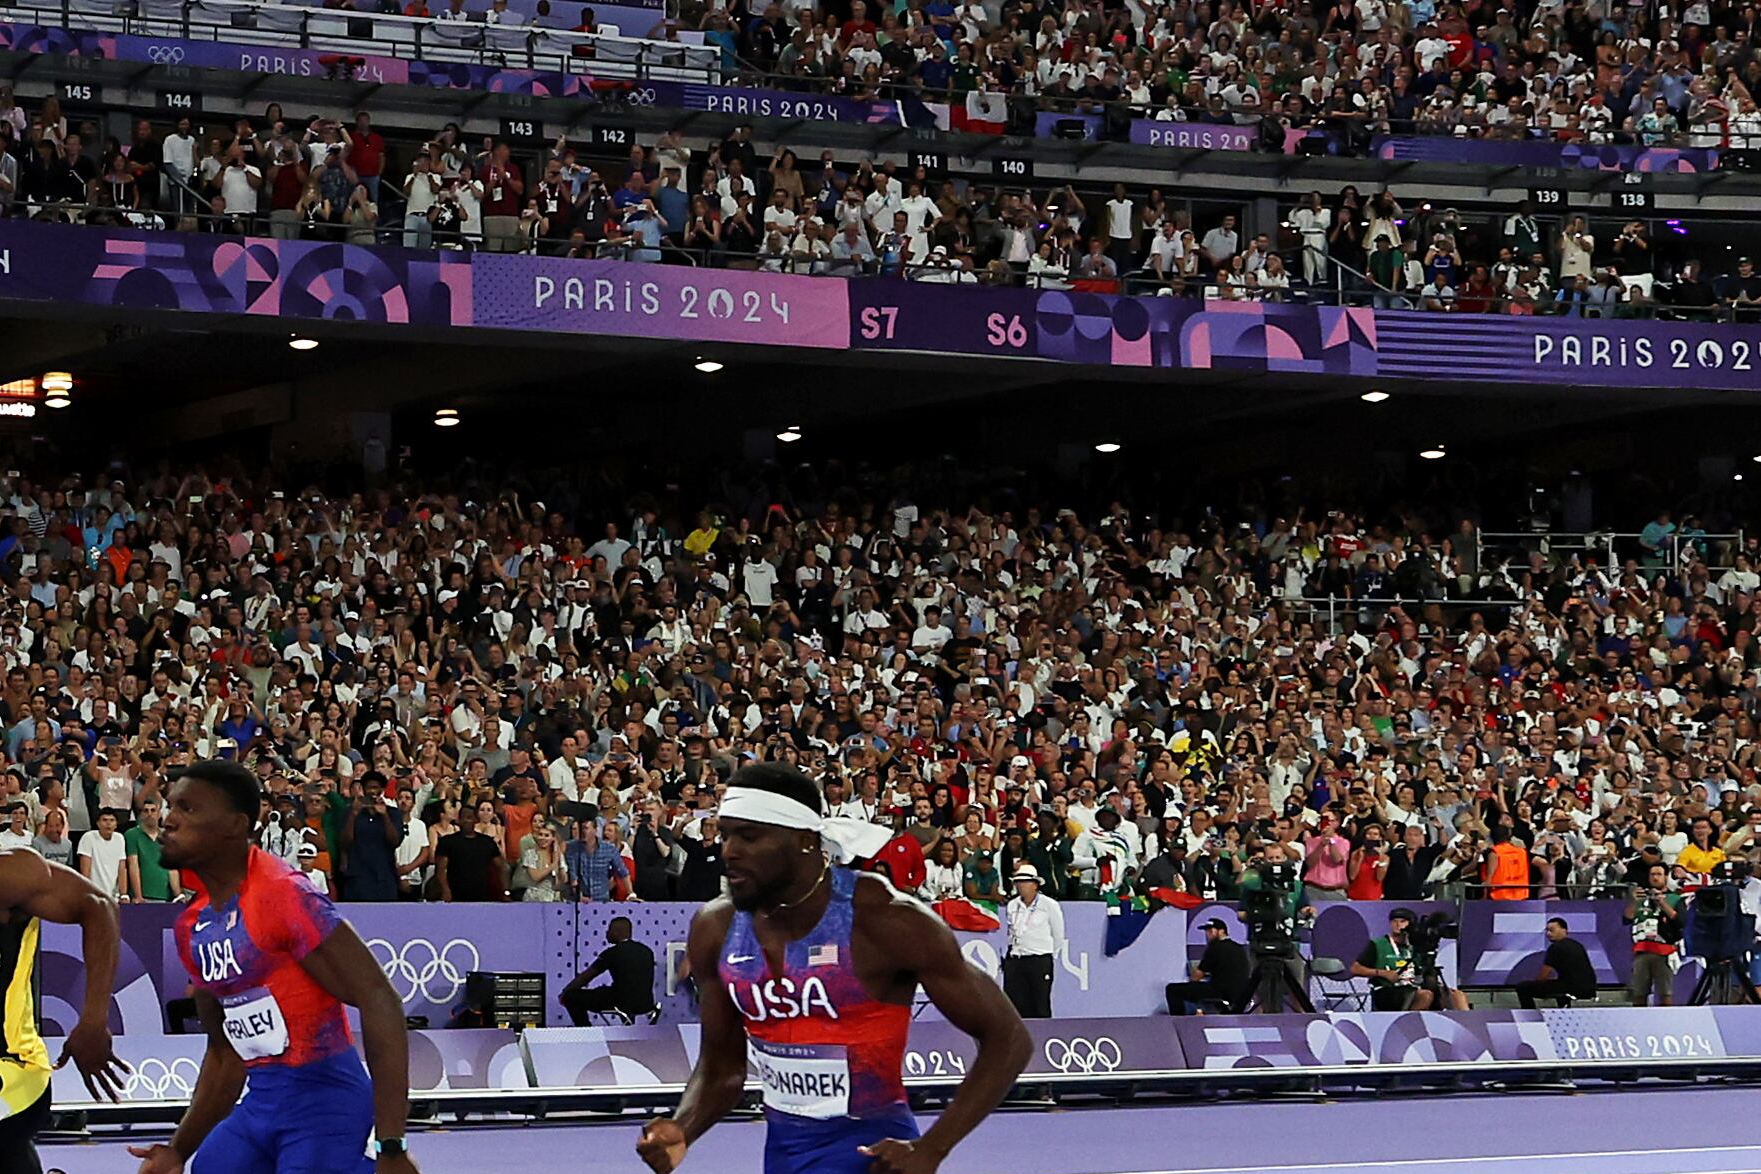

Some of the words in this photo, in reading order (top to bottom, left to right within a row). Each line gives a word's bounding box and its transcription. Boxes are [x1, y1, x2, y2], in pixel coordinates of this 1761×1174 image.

[65, 85, 91, 100] 145
[166, 93, 192, 108] 144
[780, 102, 838, 121] 2024
[509, 122, 533, 136] 143
[601, 129, 625, 143] 142
[917, 154, 939, 168] 141
[1002, 161, 1025, 175] 140
[1536, 190, 1559, 203] 139
[1621, 193, 1645, 206] 138
[680, 285, 790, 324] 2024
[861, 306, 899, 339] S7
[986, 312, 1028, 348] S6
[1670, 339, 1761, 370] 202
[199, 938, 243, 982] USA
[728, 976, 839, 1022] USA
[1646, 1034, 1713, 1057] 2024
